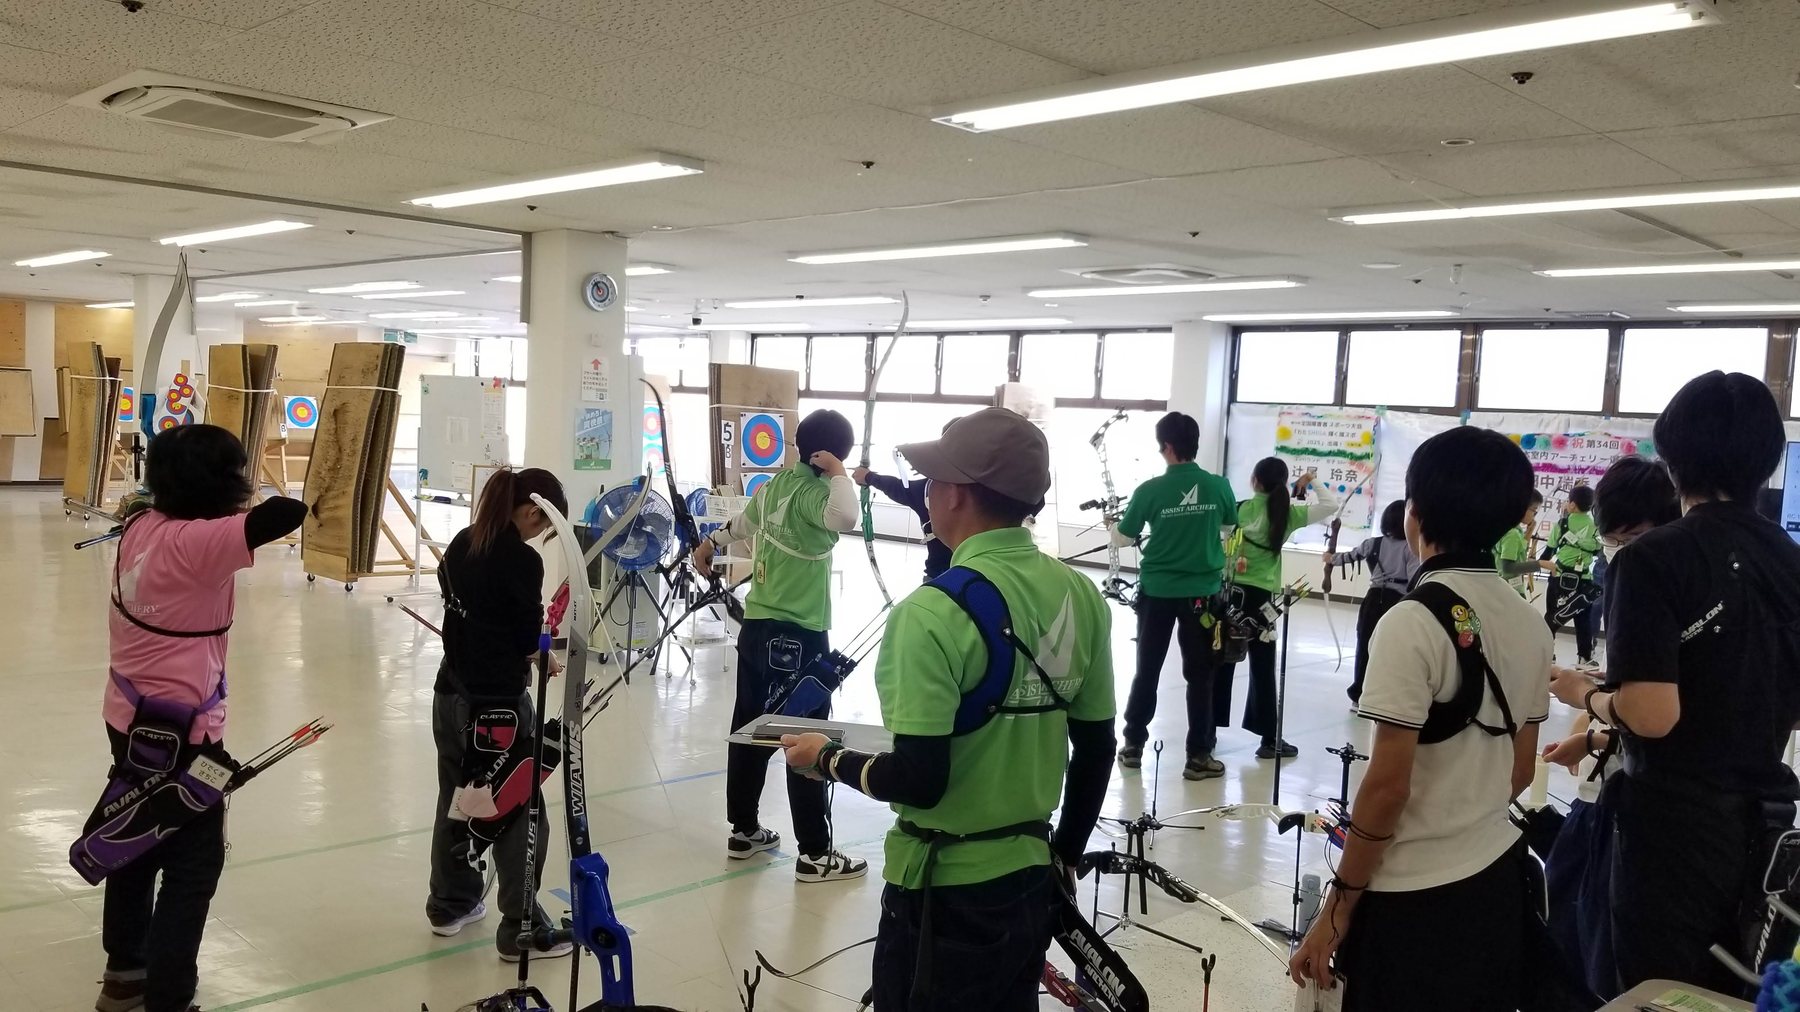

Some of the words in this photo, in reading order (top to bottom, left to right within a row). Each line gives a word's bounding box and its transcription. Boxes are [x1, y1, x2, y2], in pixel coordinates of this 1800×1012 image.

[724, 422, 732, 441] 5
[1572, 439, 1584, 448] 祝
[1586, 439, 1620, 449] 第34回
[1330, 468, 1358, 482] 玲奈
[1160, 506, 1185, 515] ASSIST
[1186, 504, 1217, 512] ARCHERY
[200, 760, 225, 778] ひでくま
[485, 751, 510, 782] LON
[569, 720, 585, 817] WIAWIS
[103, 772, 168, 818] AVALON
[526, 821, 536, 865] PLUS
[1070, 928, 1126, 998] AVALON
[1084, 963, 1119, 1008] ARCHERY
